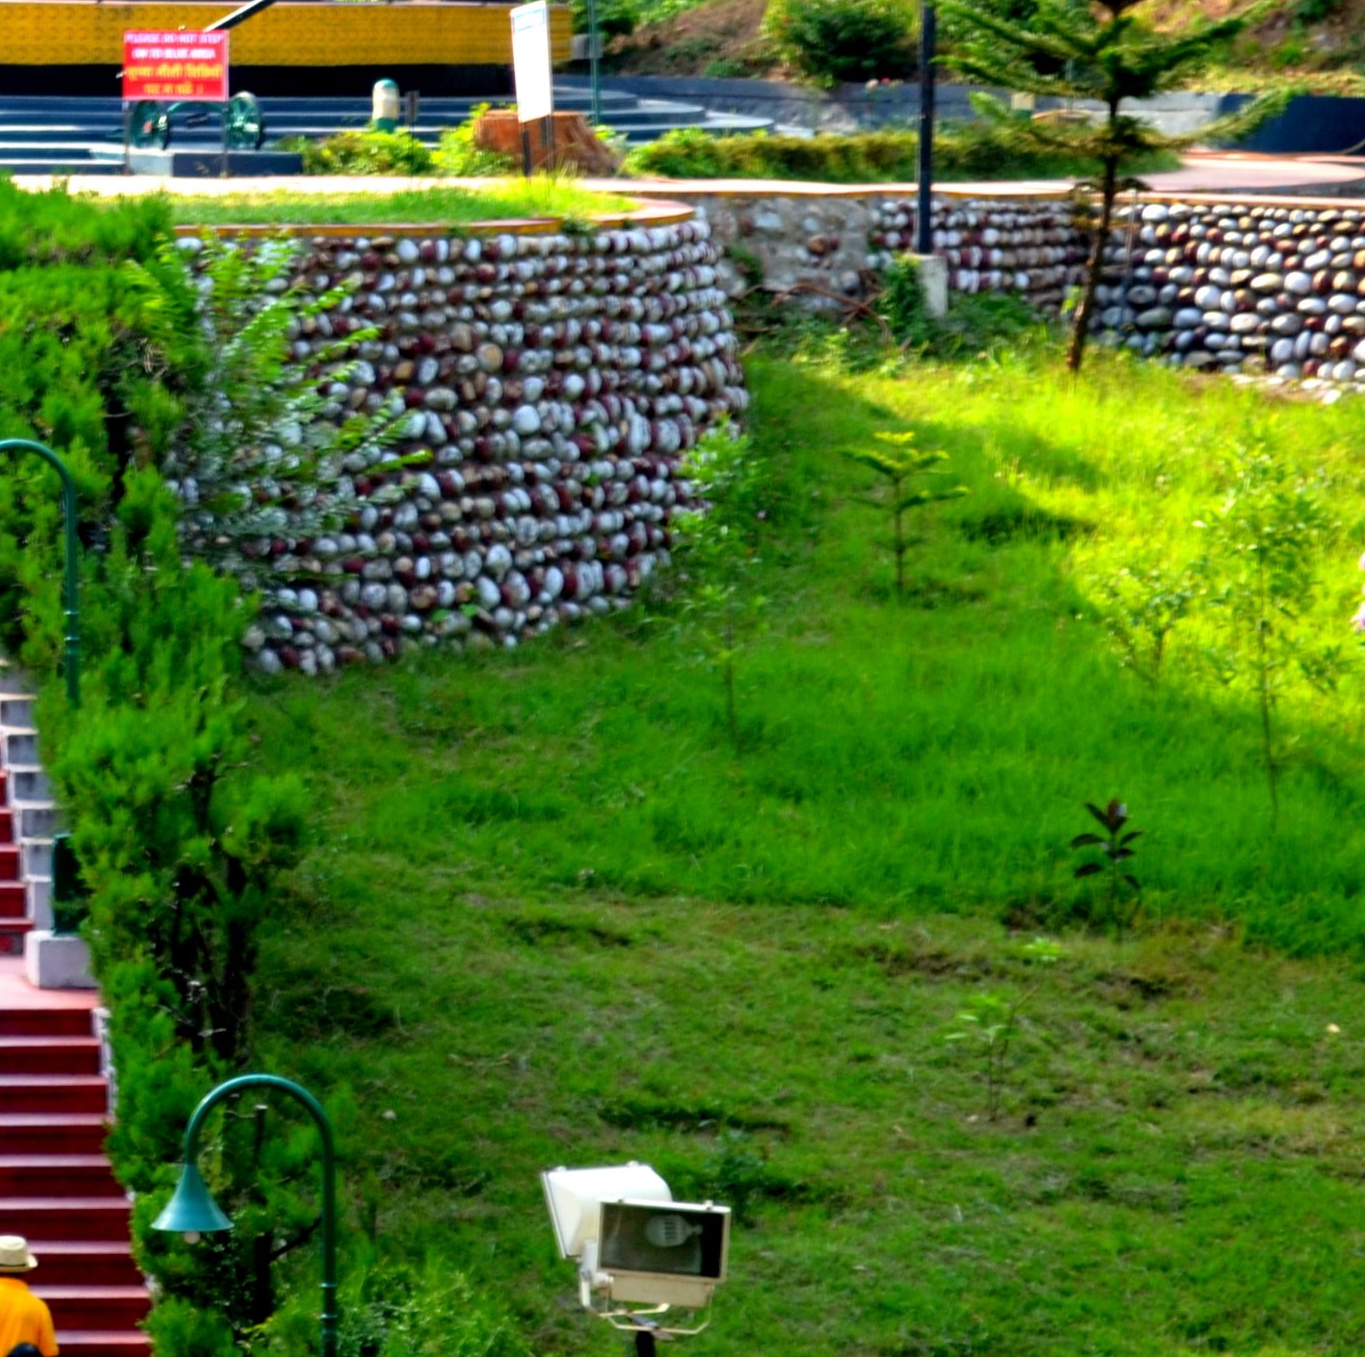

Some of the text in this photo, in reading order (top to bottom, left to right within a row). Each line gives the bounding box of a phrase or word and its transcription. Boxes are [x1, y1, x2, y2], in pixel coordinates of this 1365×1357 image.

[125, 33, 224, 44] PLEASE DO NOT STEP
